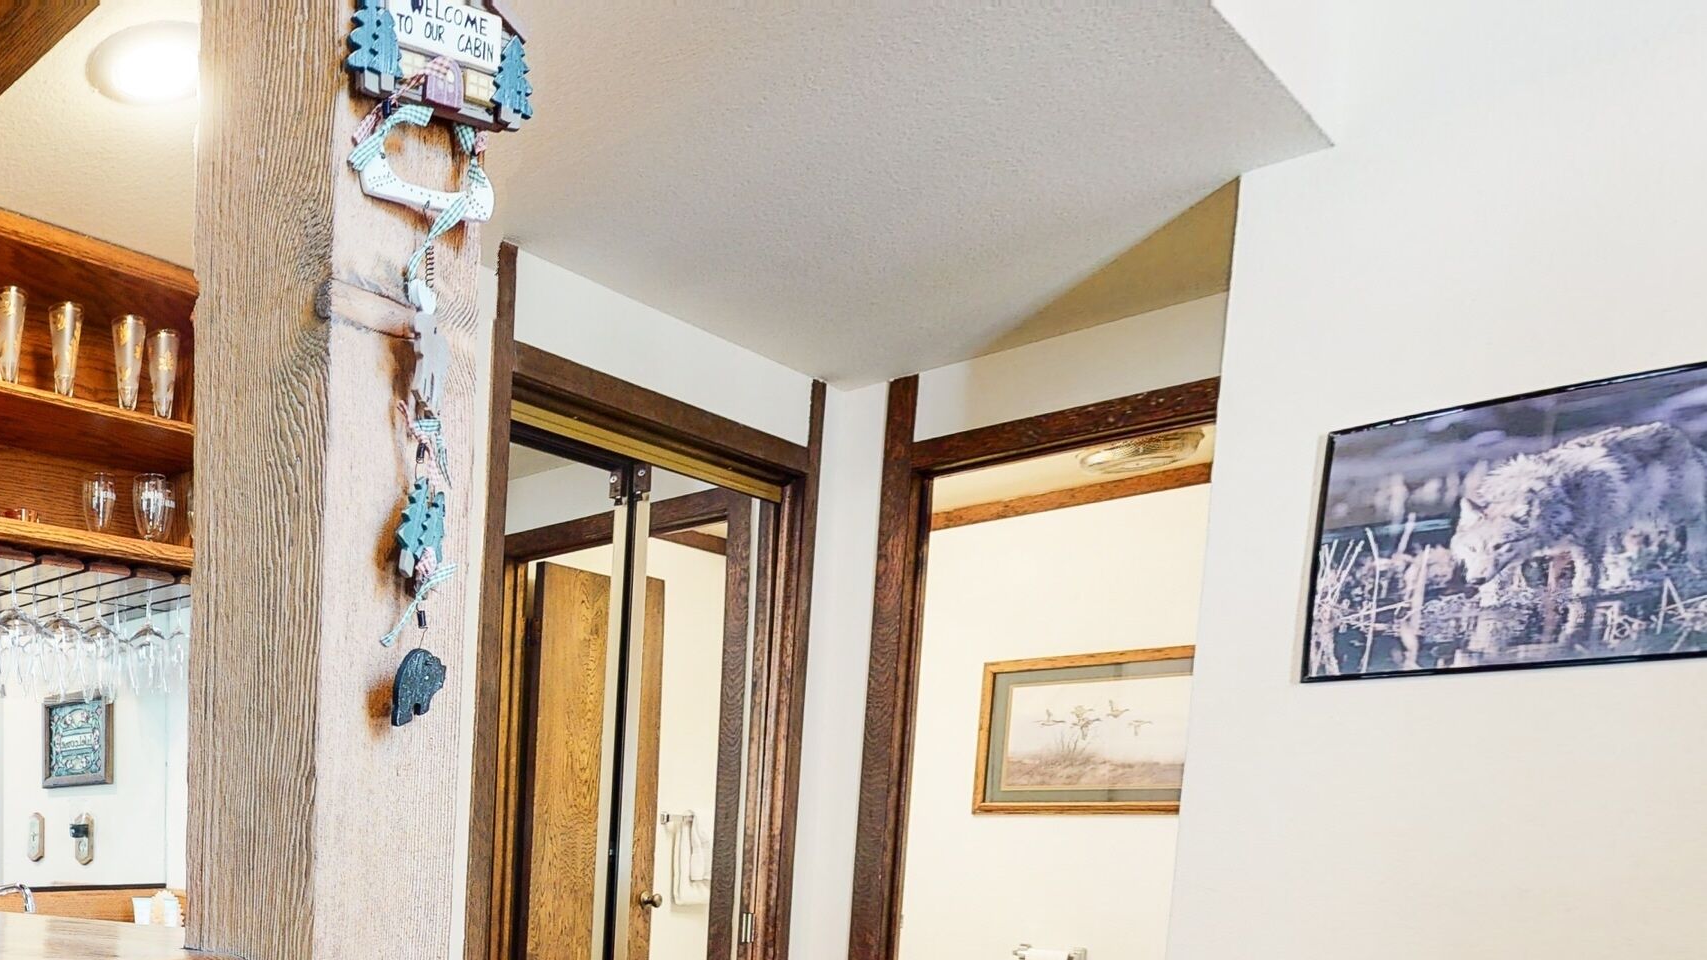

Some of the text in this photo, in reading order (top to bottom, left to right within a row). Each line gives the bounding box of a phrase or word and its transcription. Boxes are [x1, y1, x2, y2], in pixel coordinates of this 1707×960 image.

[396, 13, 494, 62] TO OUR CABIN
[410, 0, 488, 36] WELCOME
